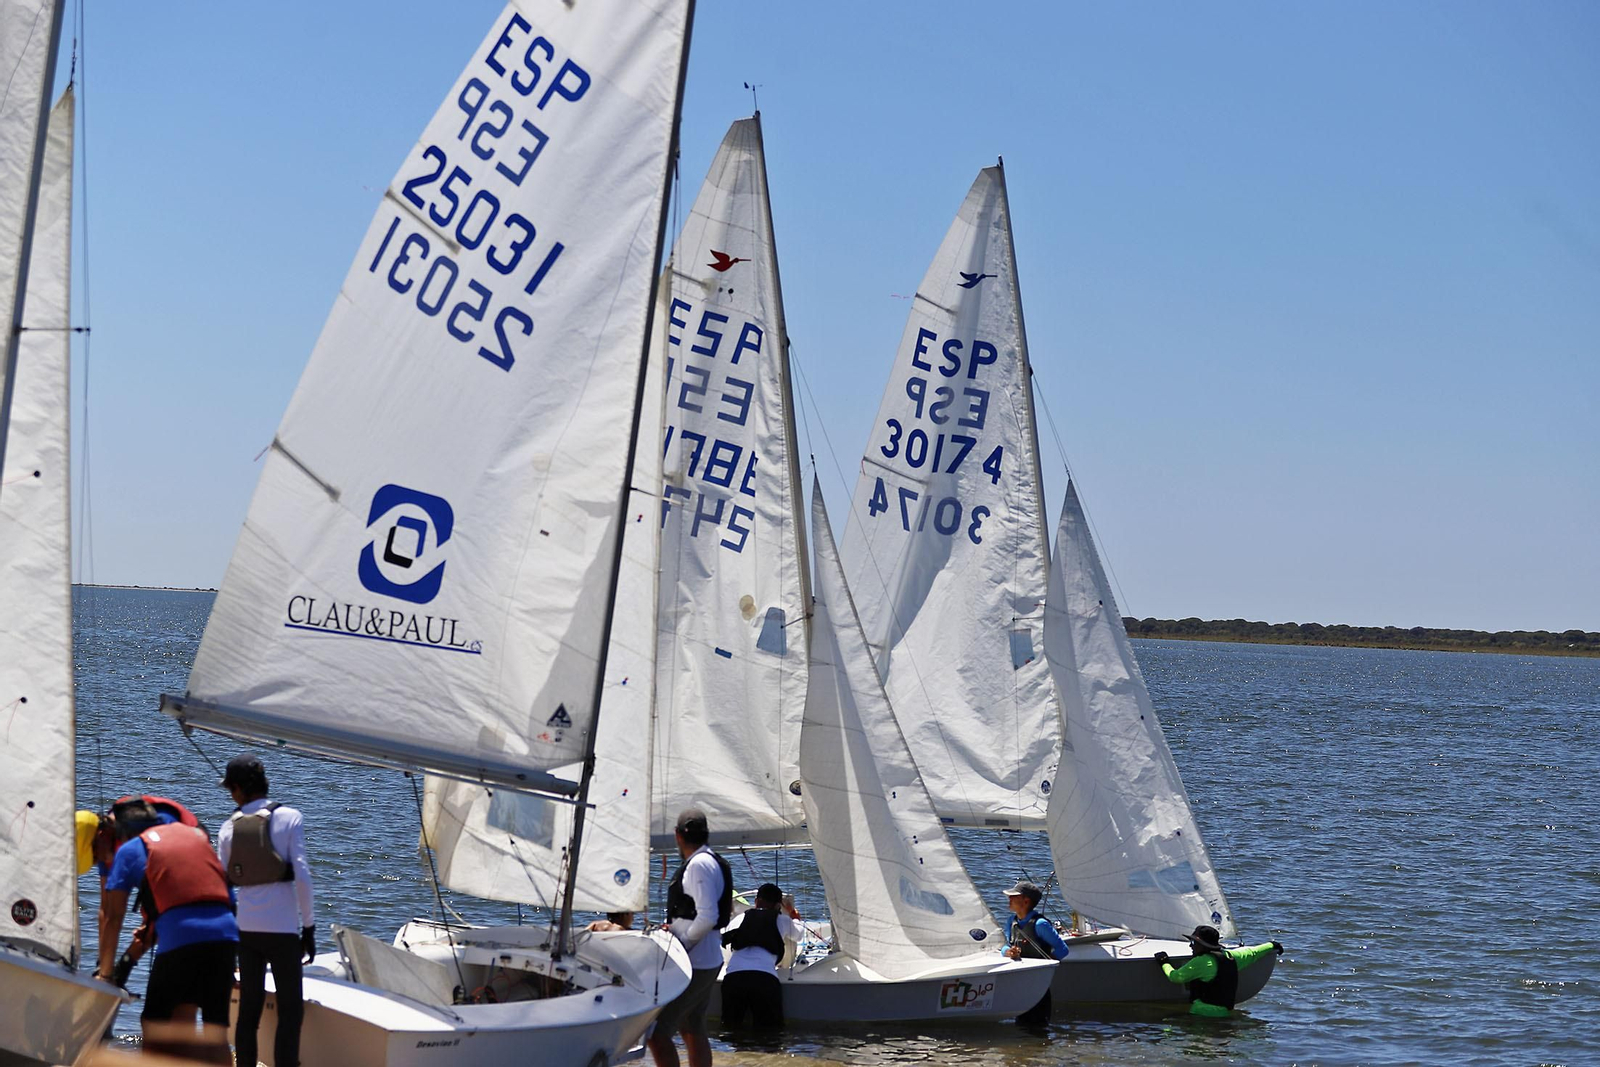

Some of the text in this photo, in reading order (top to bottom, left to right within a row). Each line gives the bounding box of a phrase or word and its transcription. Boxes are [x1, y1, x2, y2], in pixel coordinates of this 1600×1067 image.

[485, 12, 592, 111] ESP
[401, 145, 565, 296] 25031
[911, 327, 998, 379] ESP
[880, 418, 1004, 485] 30174
